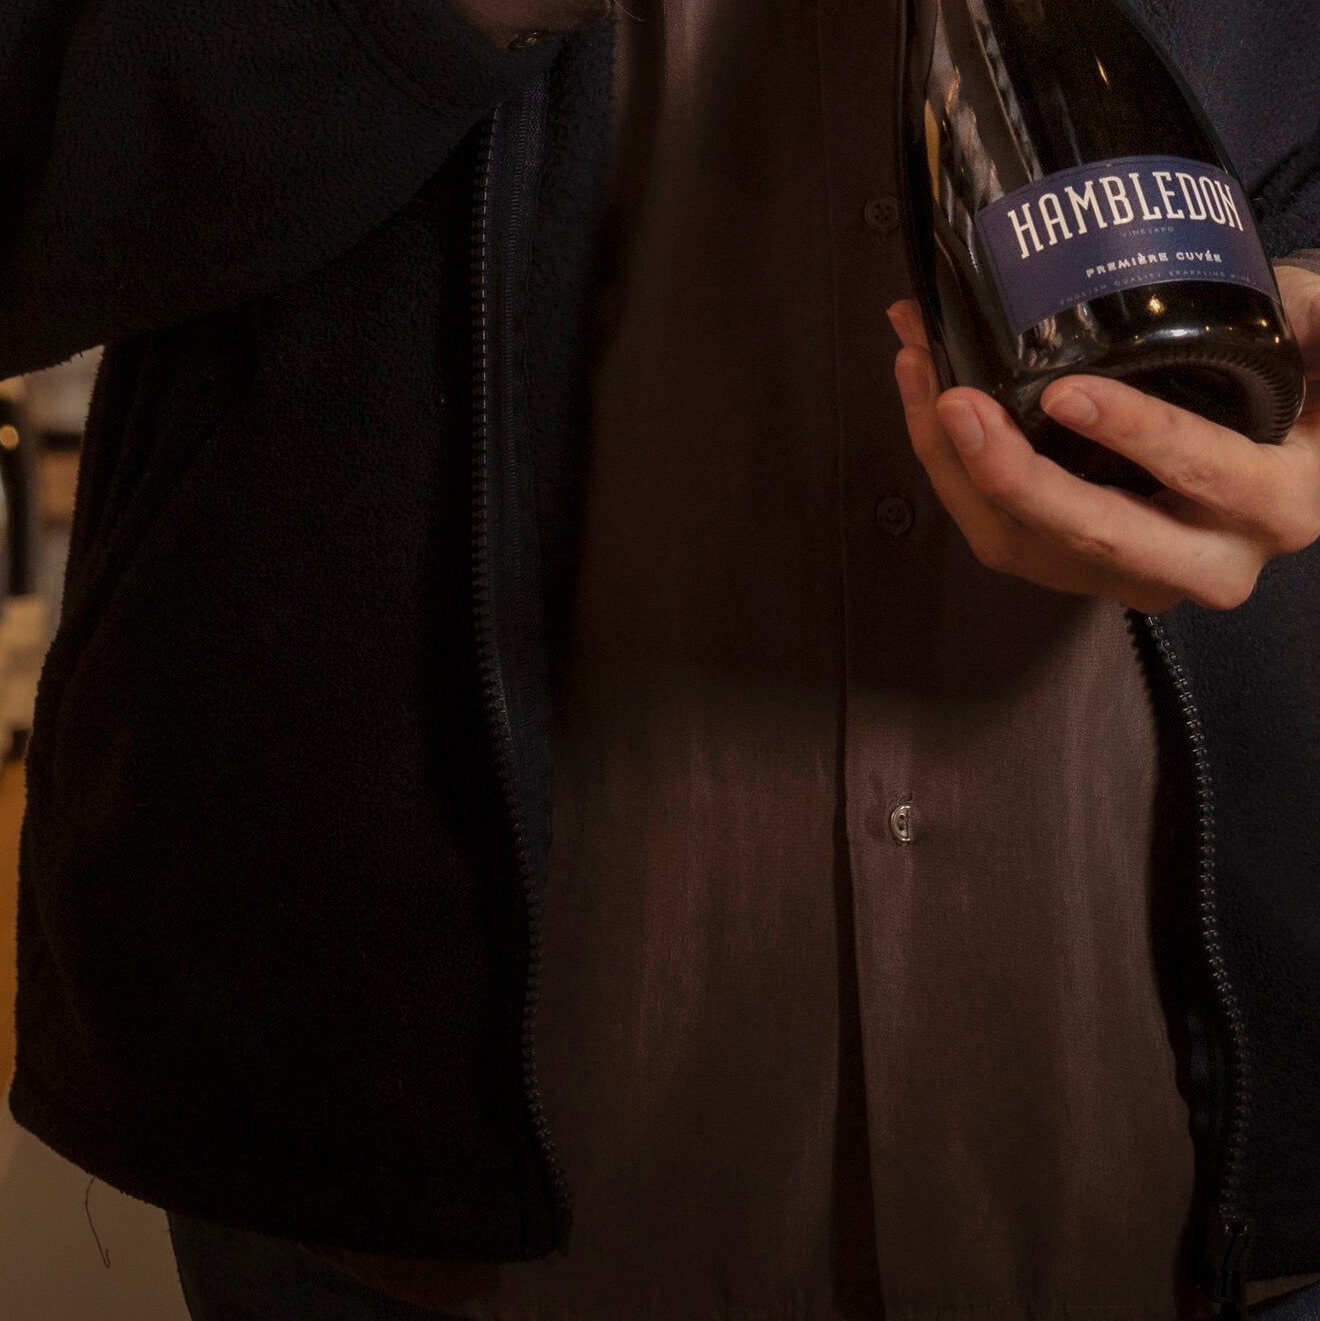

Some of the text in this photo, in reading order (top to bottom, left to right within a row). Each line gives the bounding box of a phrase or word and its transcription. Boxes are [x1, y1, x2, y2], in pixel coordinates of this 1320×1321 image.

[1007, 171, 1244, 259] HAMBLEDON
[1085, 249, 1222, 278] PREMIÈRE CUVÉE
